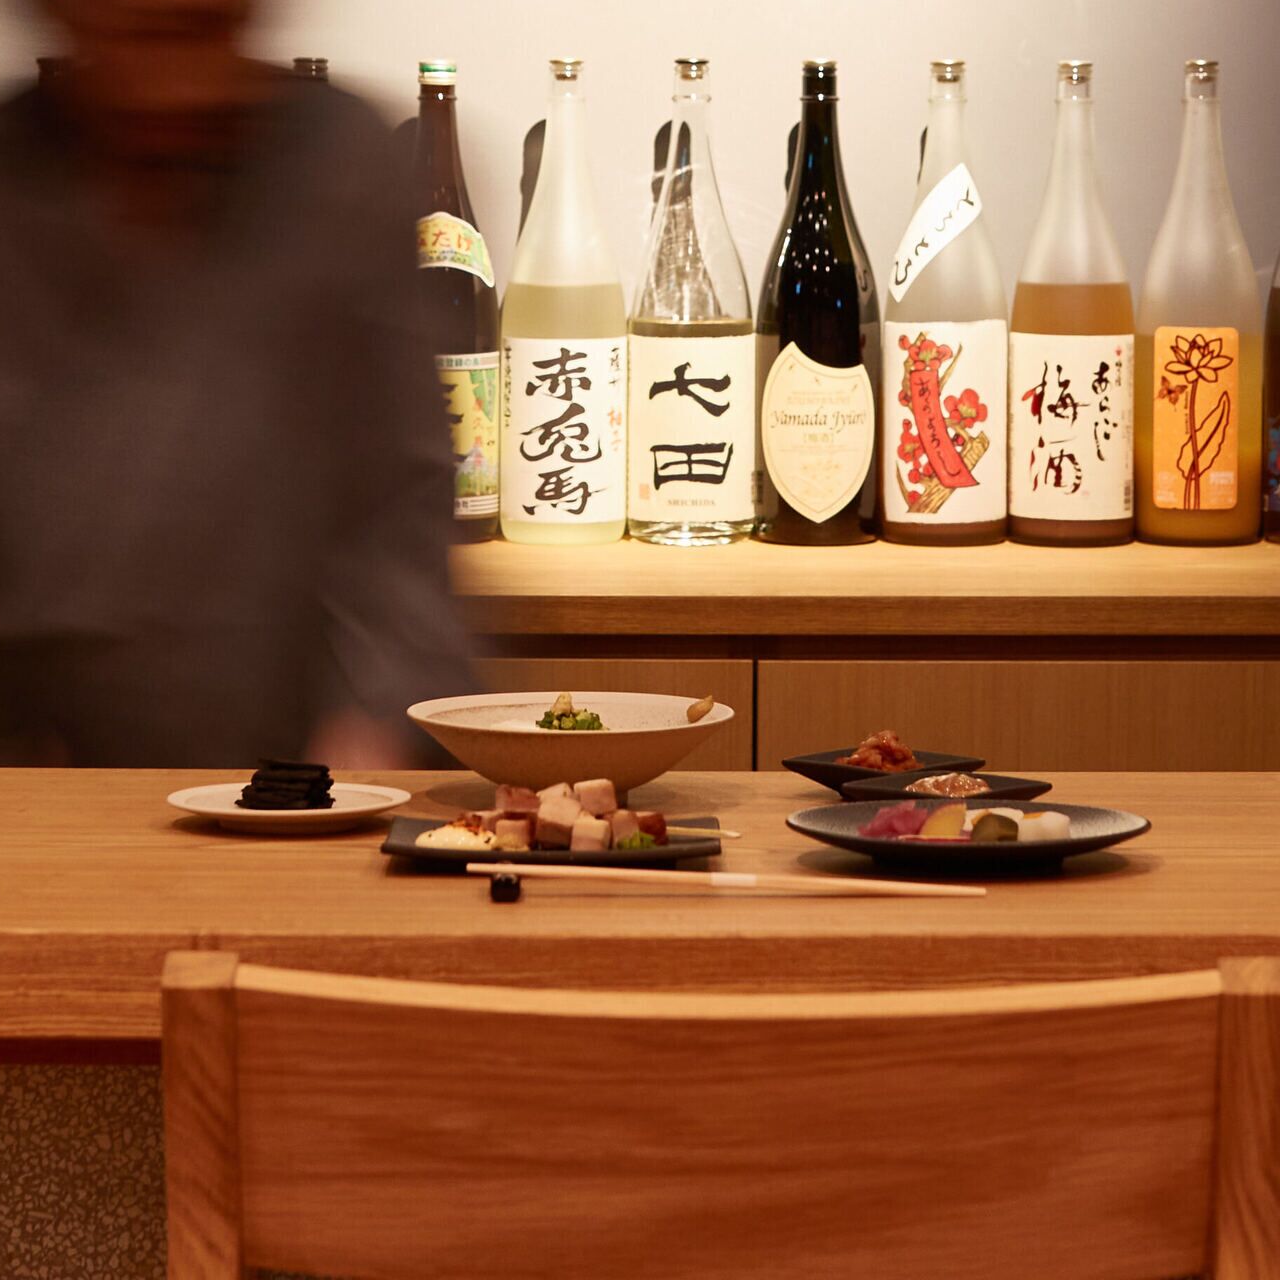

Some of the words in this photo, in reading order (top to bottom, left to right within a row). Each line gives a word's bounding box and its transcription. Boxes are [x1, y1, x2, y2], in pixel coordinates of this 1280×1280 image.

[520, 347, 608, 516] 赤兎馬
[649, 361, 733, 490] 七田
[770, 406, 827, 429] Yamada
[1021, 360, 1090, 494] 梅酒
